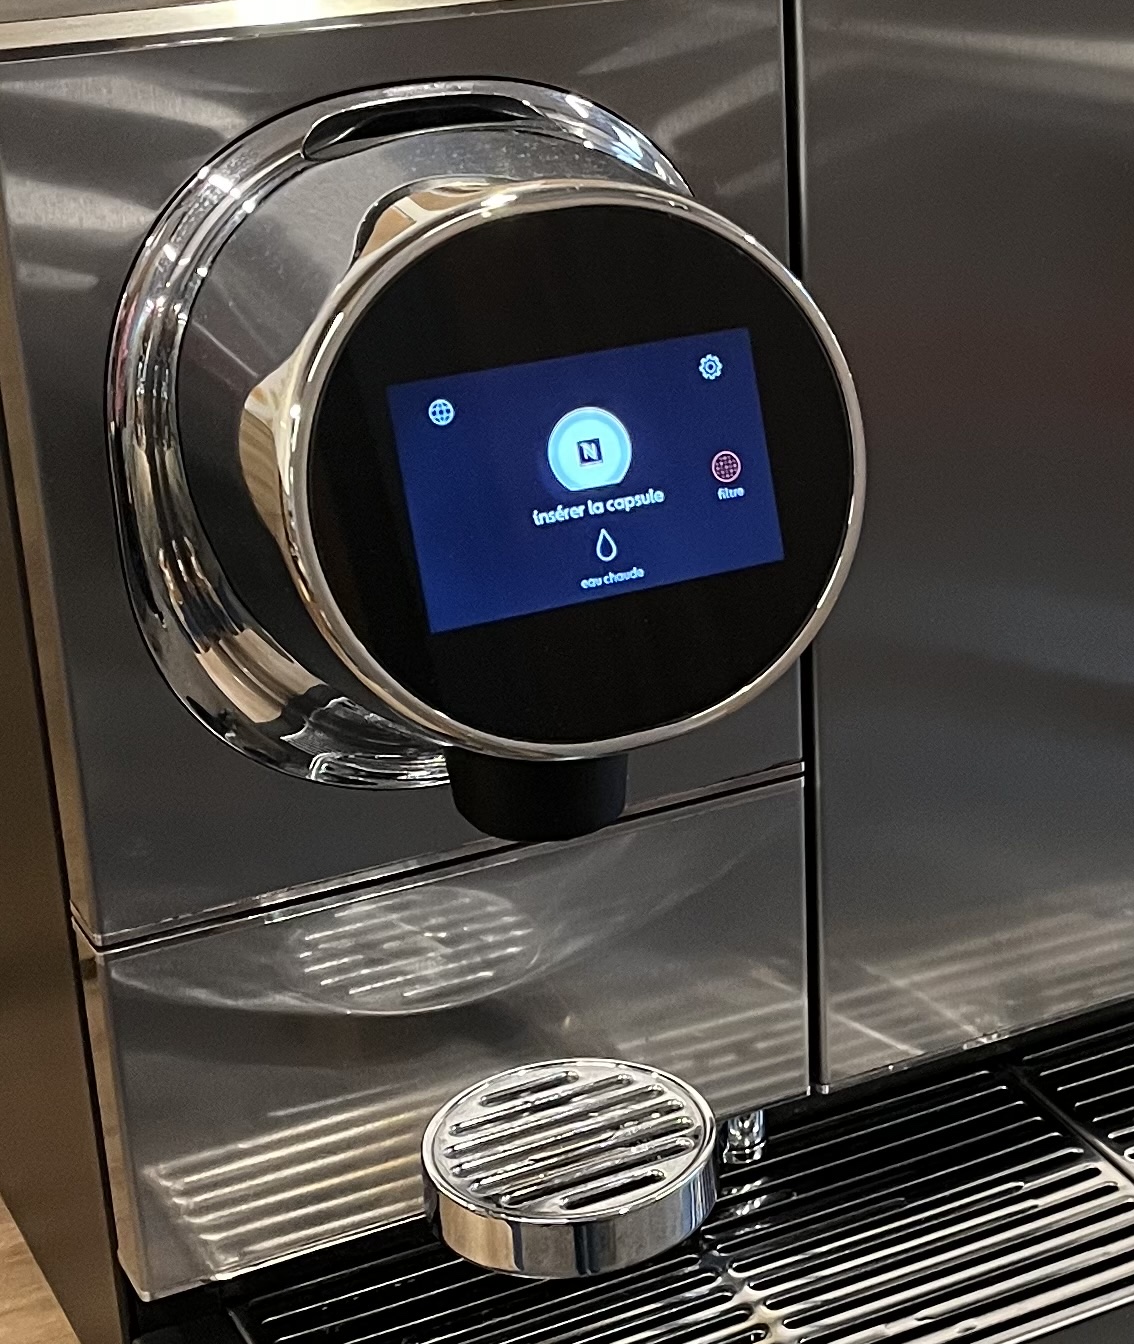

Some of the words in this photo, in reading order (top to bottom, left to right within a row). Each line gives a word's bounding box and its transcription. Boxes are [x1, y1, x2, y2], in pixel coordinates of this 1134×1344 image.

[717, 487, 745, 500] filtre
[532, 504, 586, 526] insérer
[587, 499, 604, 516] la
[605, 488, 666, 513] capsule
[580, 577, 603, 589] eau
[603, 567, 645, 585] chaude
